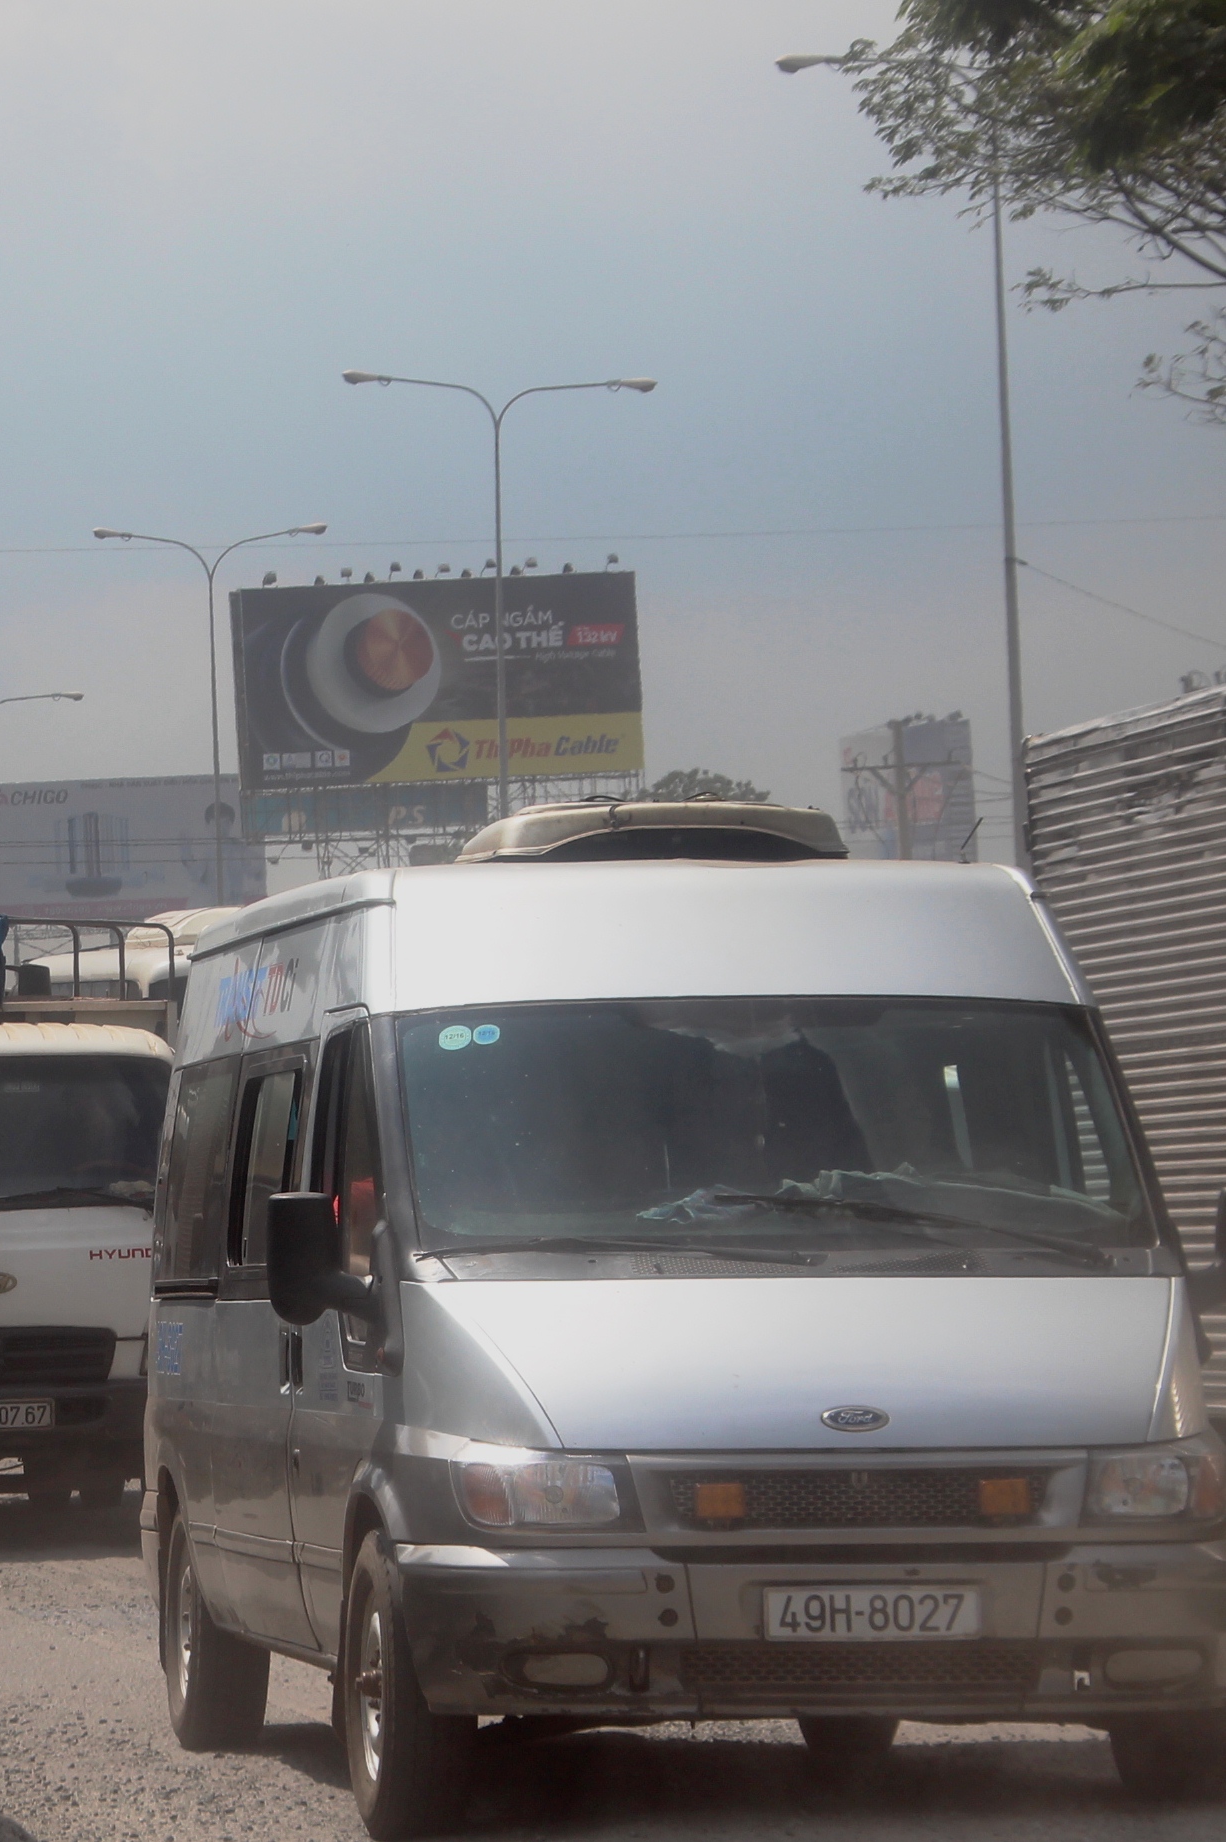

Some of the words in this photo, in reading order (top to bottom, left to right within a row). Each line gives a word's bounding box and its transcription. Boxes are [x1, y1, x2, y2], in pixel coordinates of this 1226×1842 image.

[462, 632, 512, 651] CAO
[515, 620, 564, 648] THẾ
[474, 737, 552, 759] ThPha
[554, 734, 619, 756] Cable
[10, 788, 68, 806] CHIGO
[263, 958, 299, 1017] TDCi
[837, 1409, 874, 1424] Ford
[779, 1593, 965, 1633] 49H-8027
